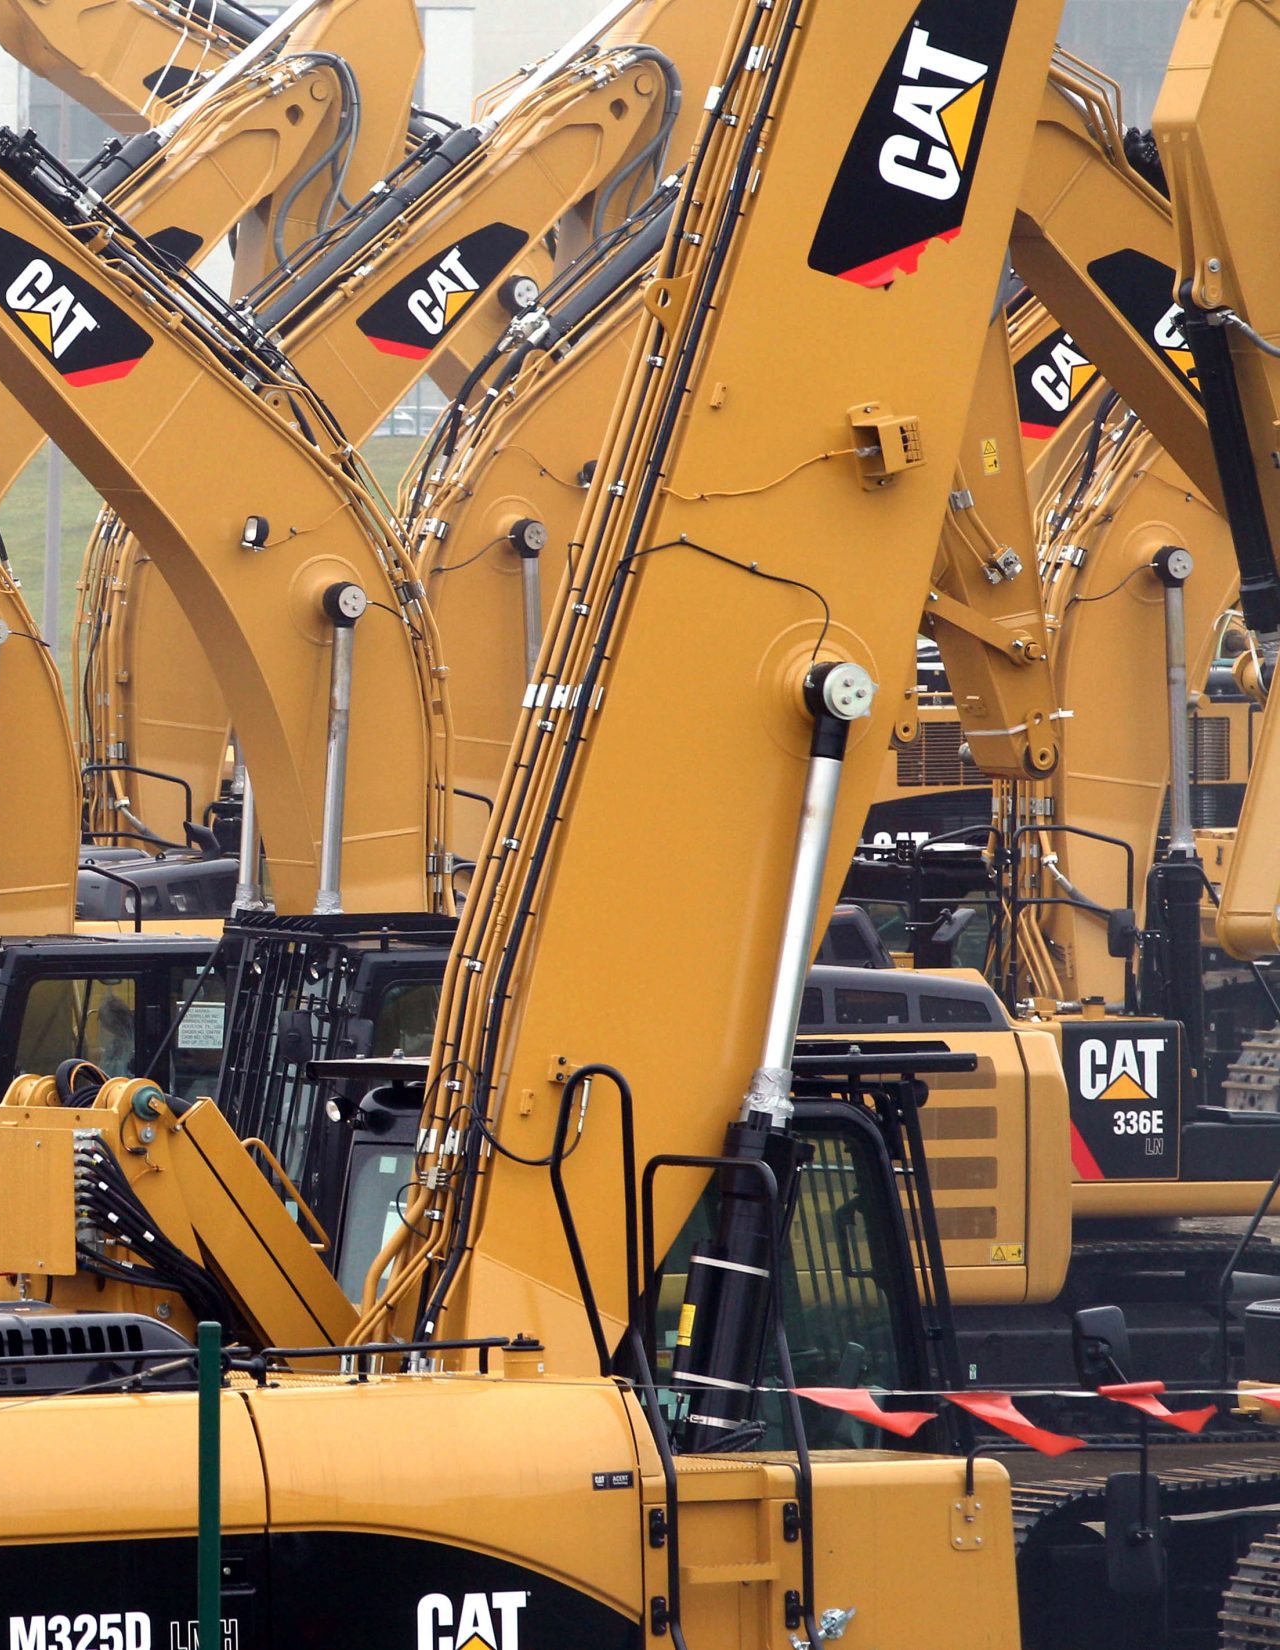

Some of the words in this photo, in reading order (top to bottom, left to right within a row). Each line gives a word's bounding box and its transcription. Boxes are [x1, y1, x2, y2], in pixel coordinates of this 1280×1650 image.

[878, 27, 988, 201] CAT
[5, 258, 98, 359] CAT
[408, 247, 480, 335] CAT
[1031, 333, 1090, 412] CA
[1079, 1038, 1165, 1100] CAT
[1113, 1110, 1163, 1135] 336E
[1145, 1138, 1163, 1155] LN
[9, 1611, 152, 1650] M325D
[417, 1591, 527, 1650] CAT
